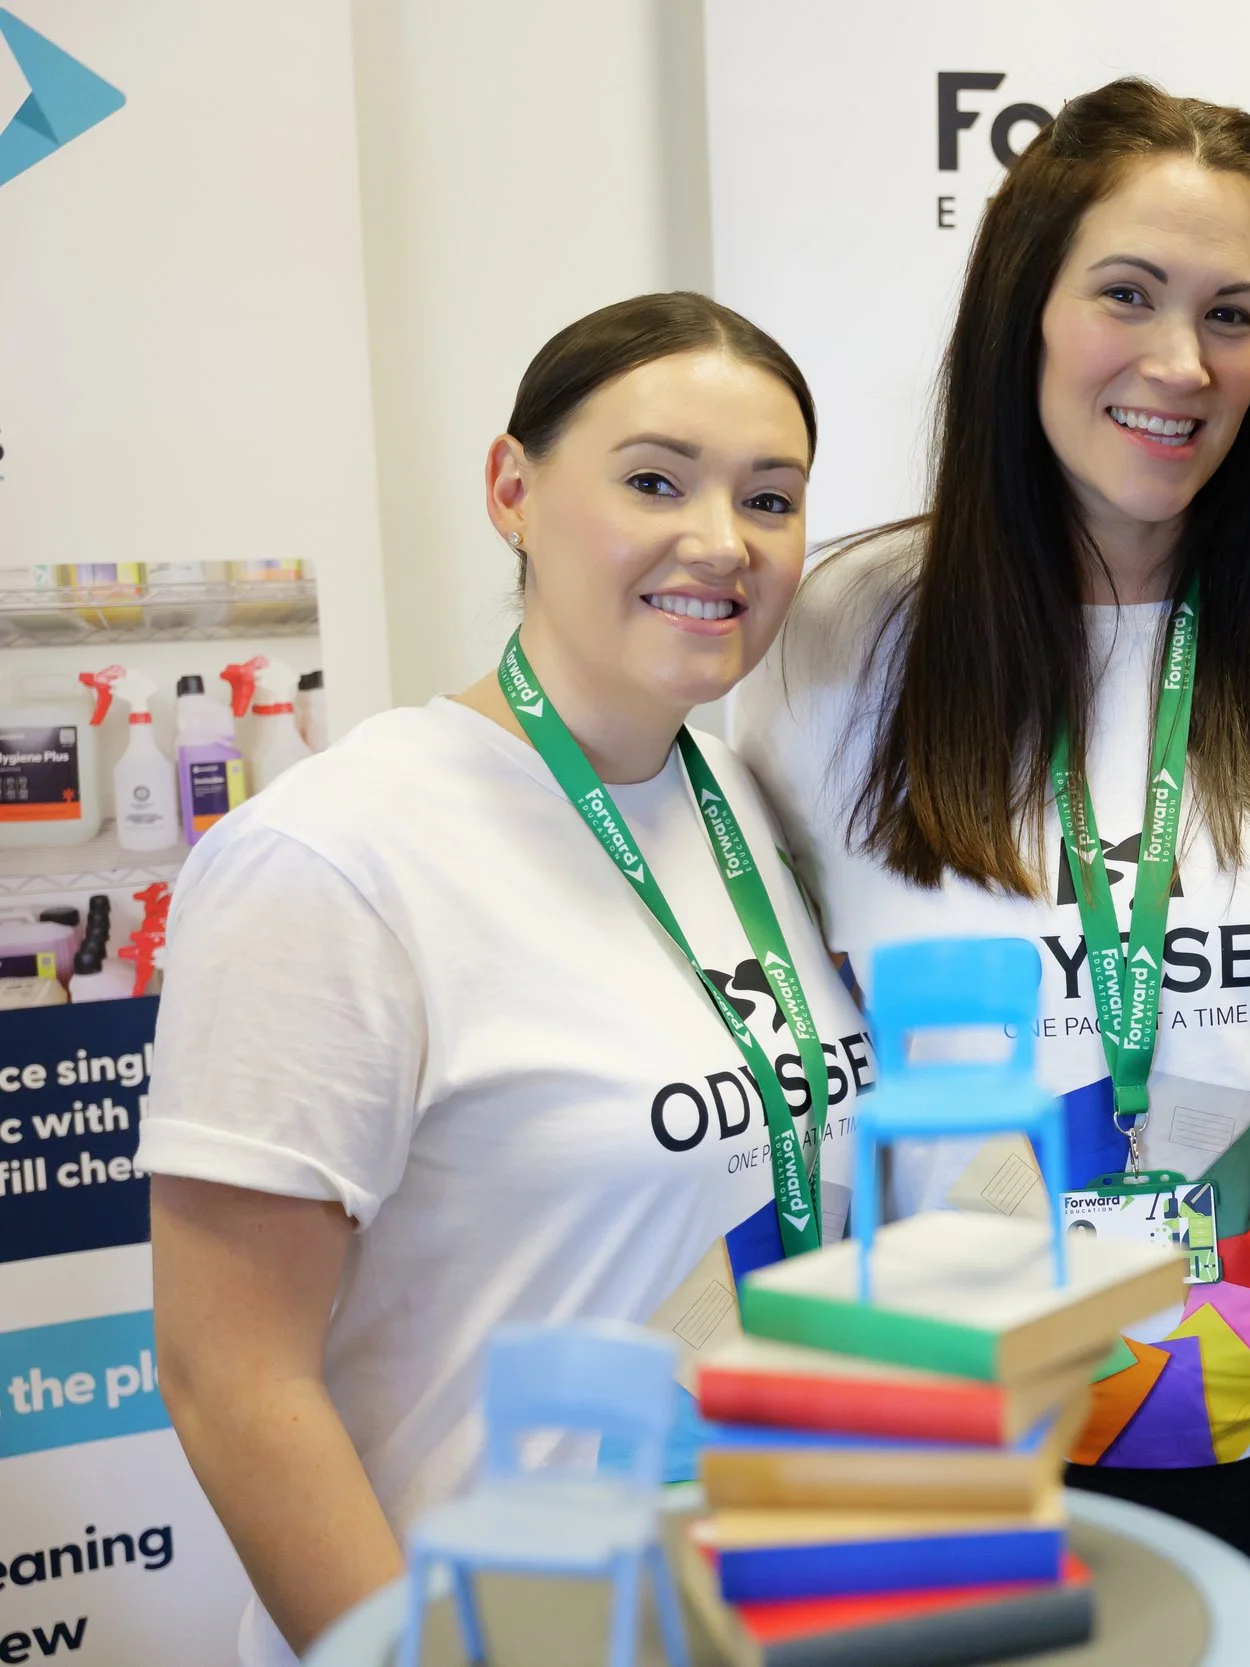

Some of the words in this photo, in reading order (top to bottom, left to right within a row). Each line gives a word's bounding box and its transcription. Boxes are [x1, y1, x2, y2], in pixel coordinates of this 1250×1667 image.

[1165, 618, 1187, 690] Forward
[578, 798, 620, 861] EDUCATION
[585, 788, 638, 866] Forward
[704, 805, 744, 879] Forward
[1143, 788, 1169, 862] Forward
[1162, 799, 1176, 862] EDUCATION
[768, 968, 810, 1039] Forward
[1092, 950, 1109, 1021] EDUCATION
[1124, 967, 1148, 1050] Forward
[1143, 979, 1155, 1050] EDUCATION
[1171, 1010, 1187, 1030] A
[1193, 1004, 1249, 1028] TIME
[31, 1098, 129, 1140] with
[651, 1031, 880, 1152] ODSSE
[728, 1148, 758, 1174] ONE
[823, 1122, 834, 1142] A
[57, 1151, 150, 1188] che
[775, 1135, 788, 1202] EDUCATION
[781, 1129, 808, 1211] Forward
[1064, 1195, 1120, 1209] Forward
[1065, 1207, 1113, 1215] EDUCATION
[9, 1367, 96, 1415] the
[105, 1349, 158, 1409] pl
